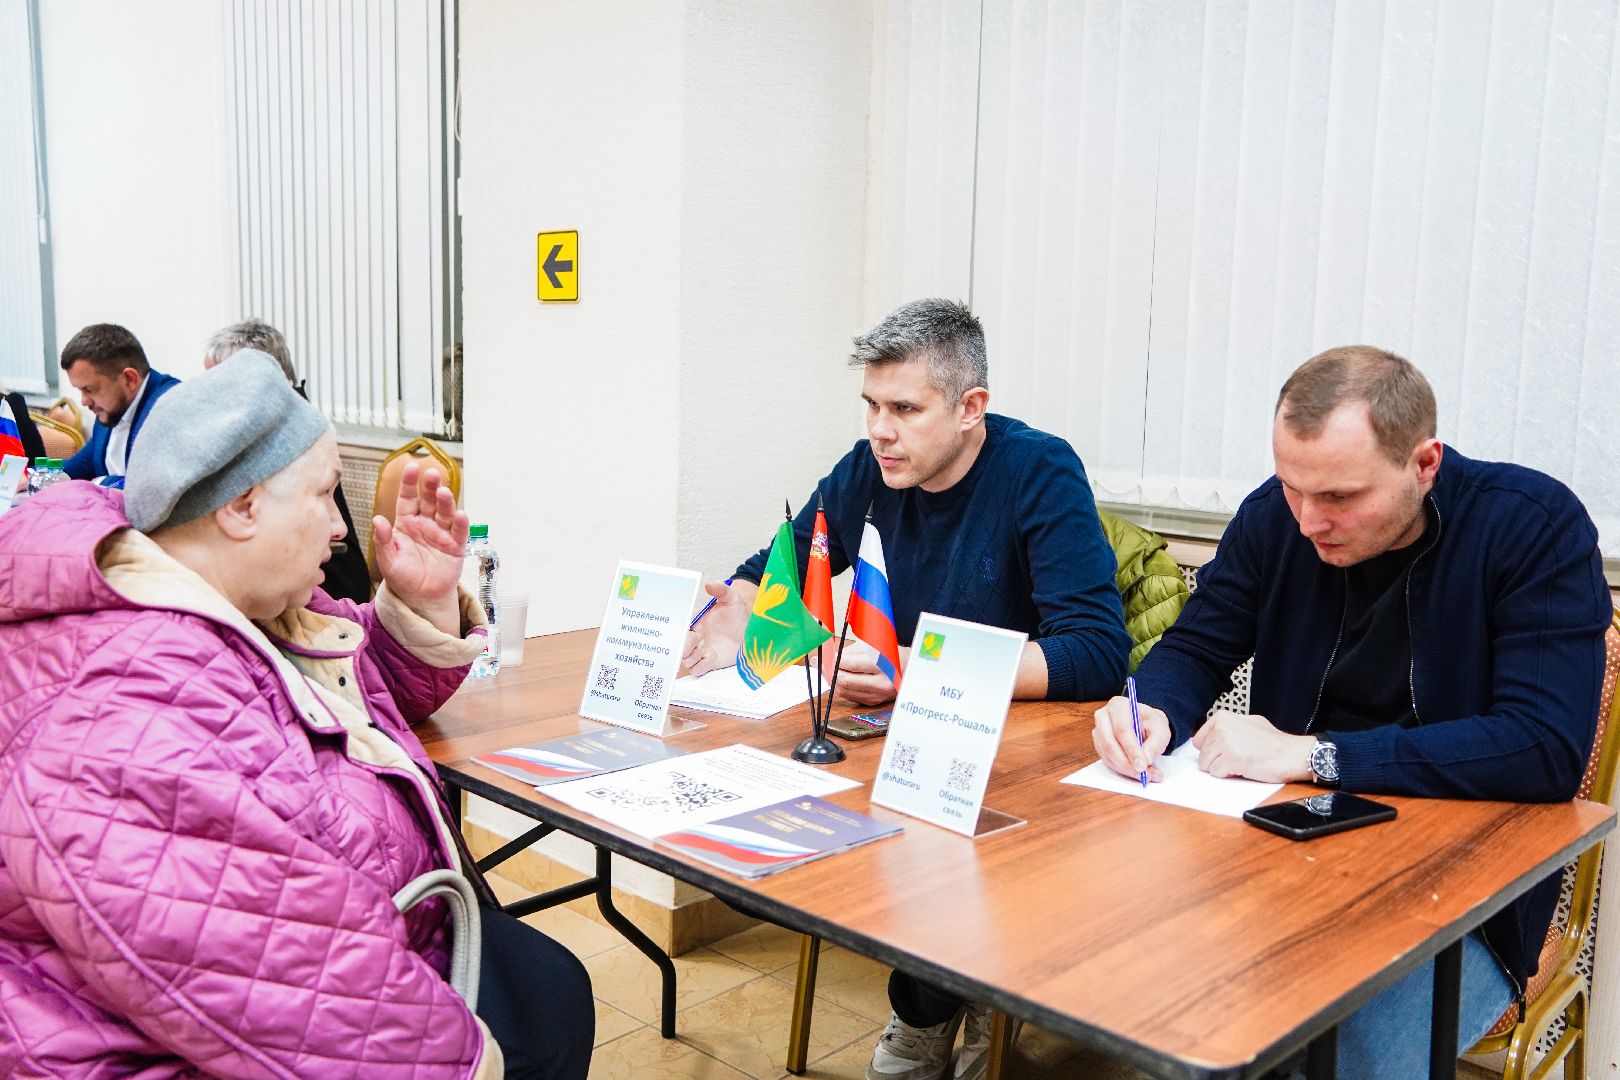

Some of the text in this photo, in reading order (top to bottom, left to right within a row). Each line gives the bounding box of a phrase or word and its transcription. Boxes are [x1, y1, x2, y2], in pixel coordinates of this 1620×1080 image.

[621, 606, 670, 624] Управление
[620, 623, 663, 638] жилищно-
[606, 636, 670, 655] коммунального
[615, 653, 655, 667] хозяйства
[939, 686, 964, 701] МБУ
[900, 702, 997, 735] «Прогресс-Рошаль»
[882, 773, 921, 790] @shaturaru
[938, 789, 974, 807] Обратная
[942, 807, 963, 819] связь
